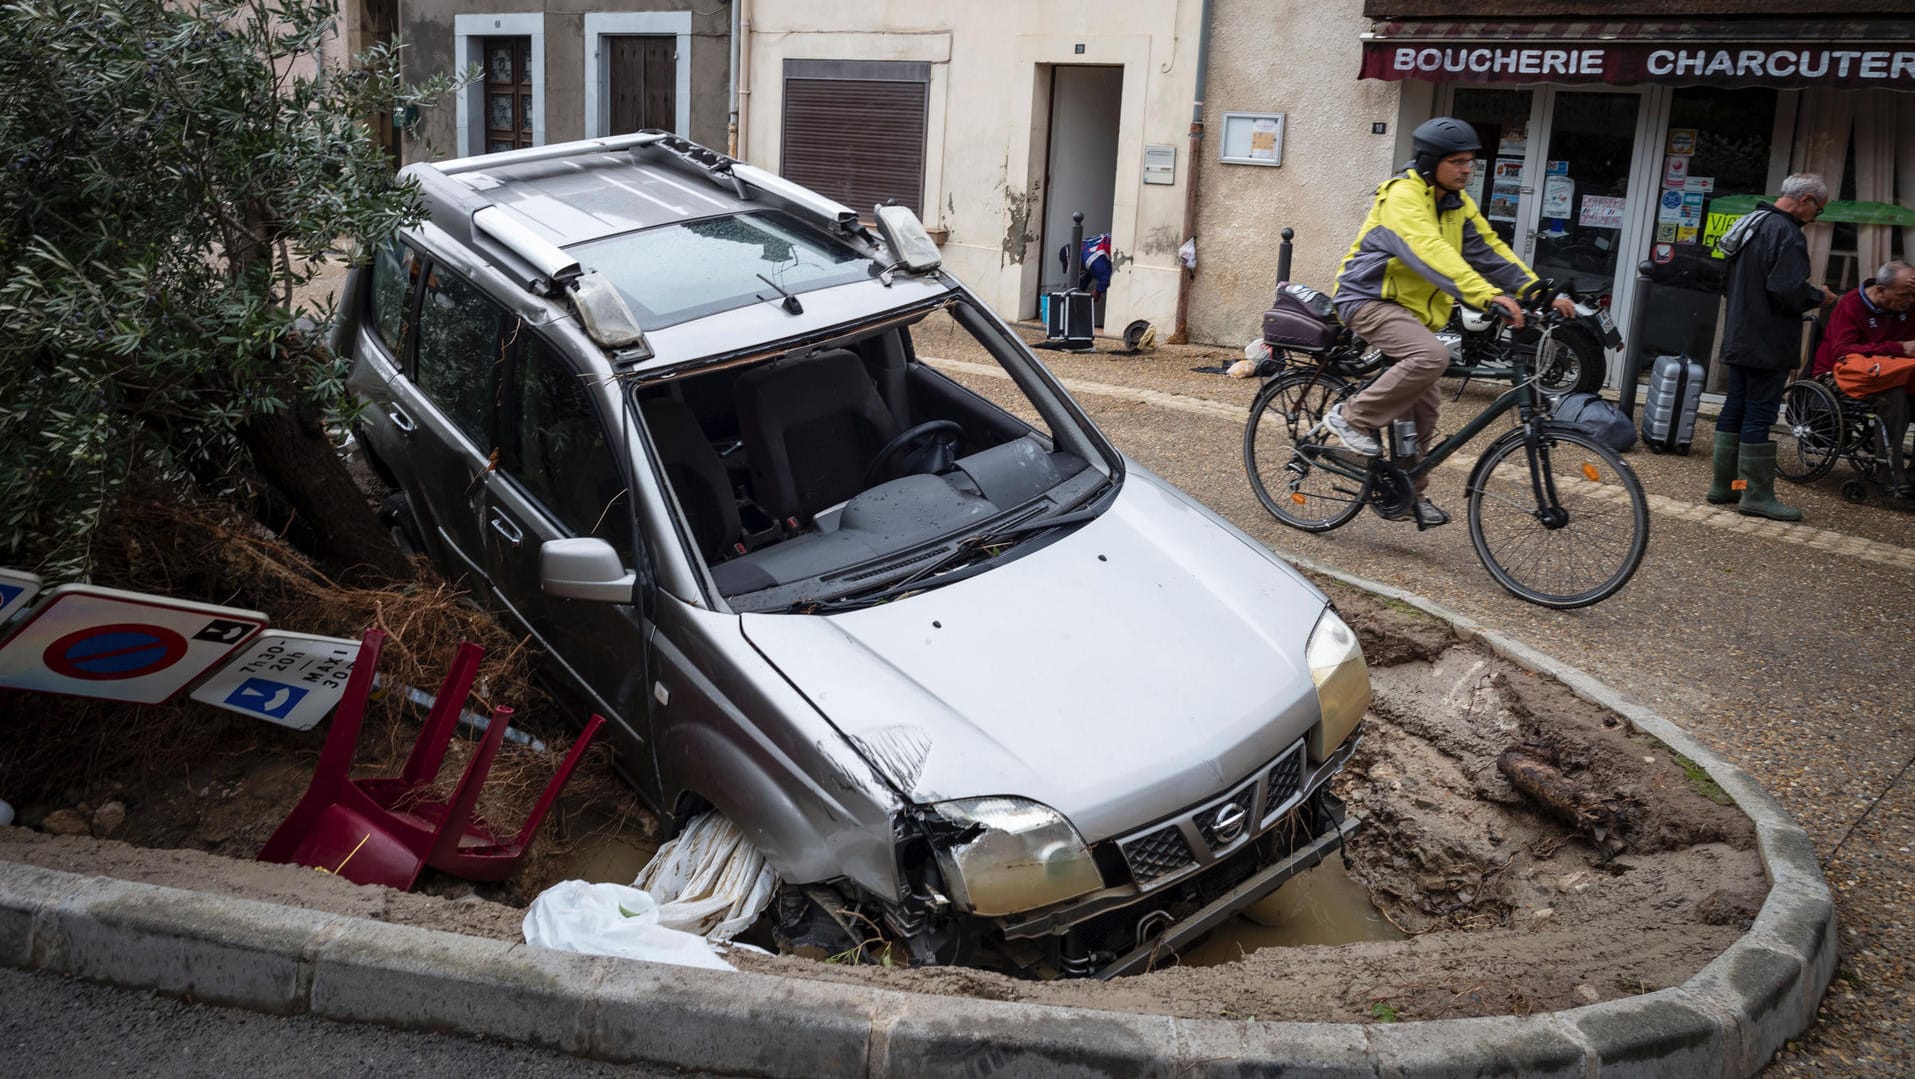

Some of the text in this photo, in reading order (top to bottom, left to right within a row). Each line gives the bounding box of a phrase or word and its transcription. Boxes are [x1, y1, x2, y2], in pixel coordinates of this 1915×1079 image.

[1393, 48, 1915, 79] BOUCHERIE CHARCUTER
[268, 651, 306, 671] 20h
[302, 650, 348, 683] MAXI
